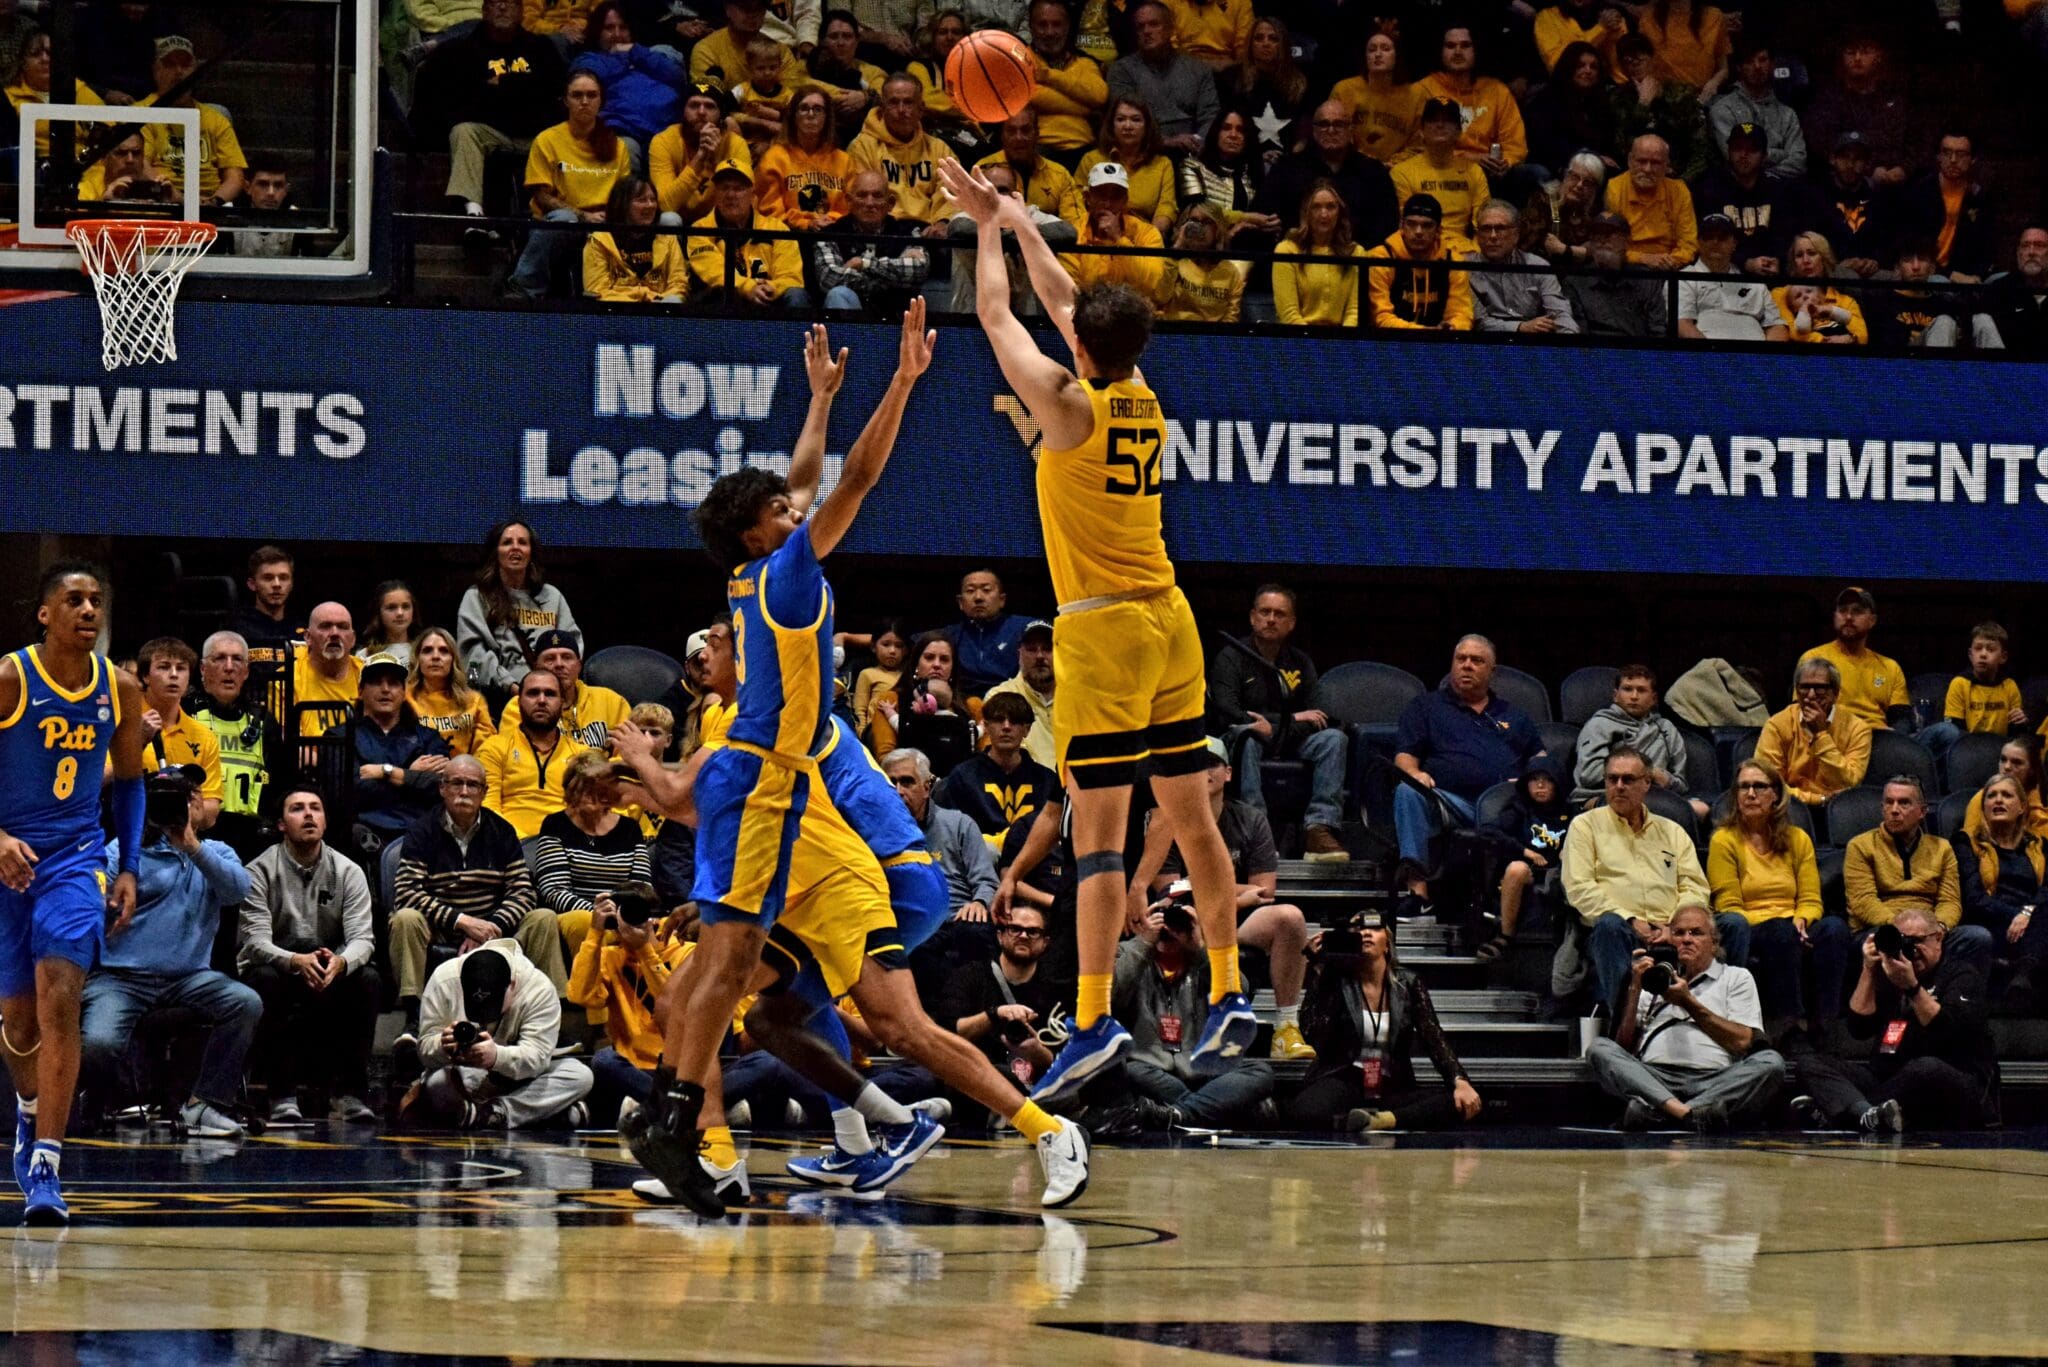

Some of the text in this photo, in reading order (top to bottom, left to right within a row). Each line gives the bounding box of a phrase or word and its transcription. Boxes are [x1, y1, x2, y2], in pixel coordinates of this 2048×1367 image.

[594, 343, 781, 420] Now
[1105, 427, 1161, 496] 52
[1160, 418, 2048, 505] NIVERSITY APARTMENT
[38, 715, 96, 750] Pitt
[53, 756, 78, 800] 8
